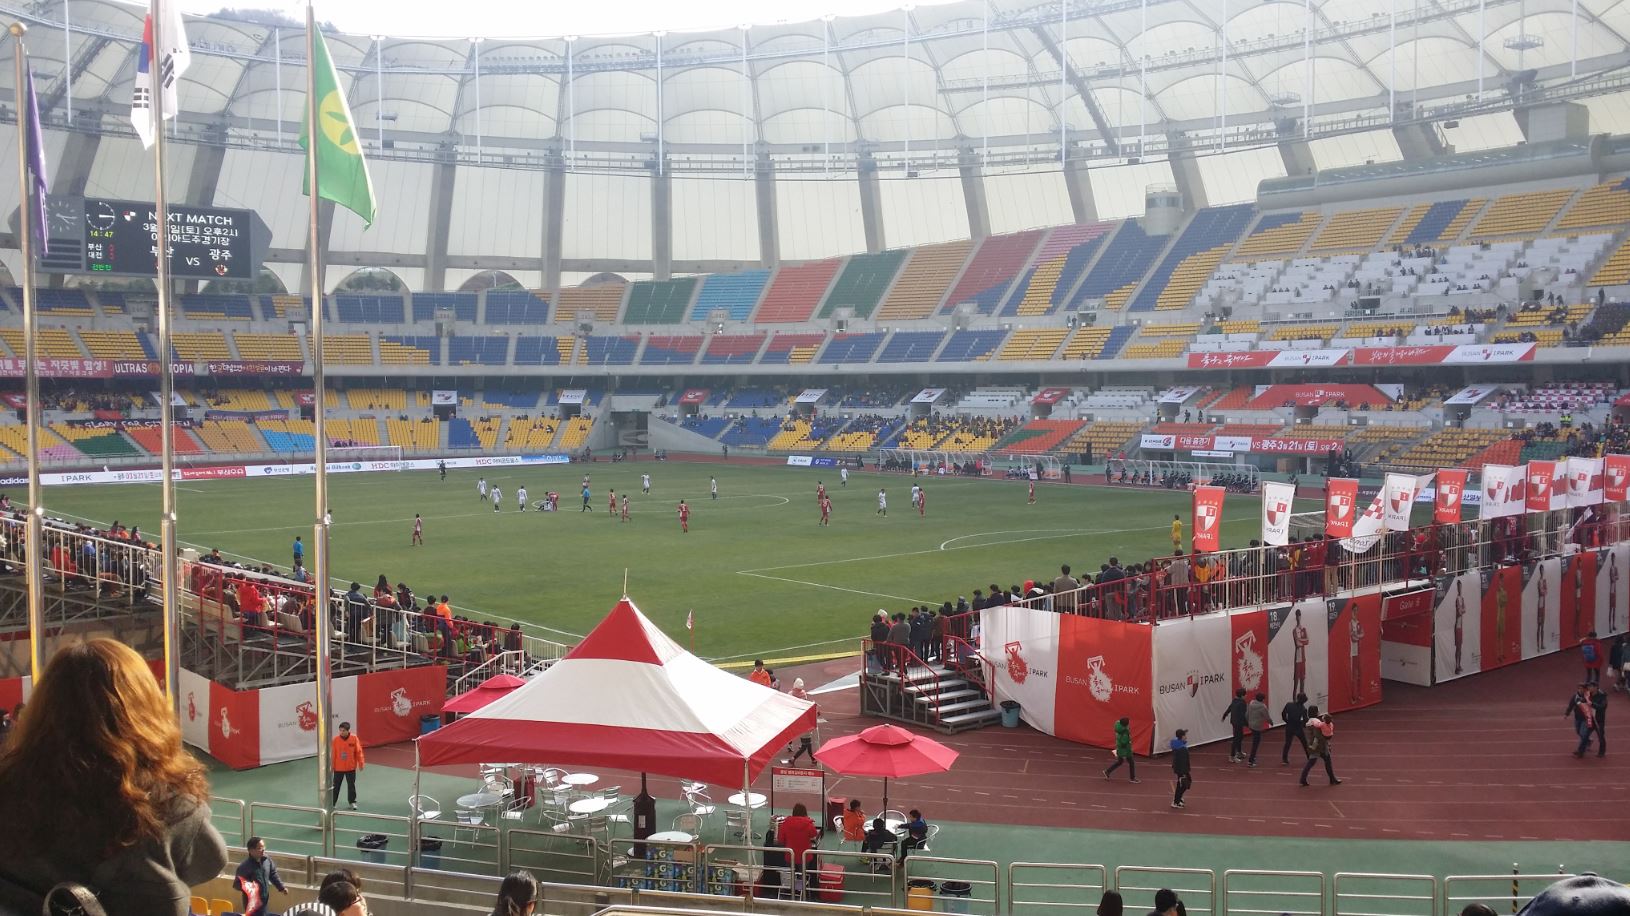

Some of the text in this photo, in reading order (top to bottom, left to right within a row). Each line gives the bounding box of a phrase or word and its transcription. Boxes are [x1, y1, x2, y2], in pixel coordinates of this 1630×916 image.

[148, 211, 233, 225] NXT MATCH
[203, 227, 238, 237] 오후2시
[88, 243, 102, 251] 부산
[209, 248, 233, 261] 광주
[185, 257, 200, 266] VS
[114, 362, 148, 374] ULTRAS
[1251, 441, 1261, 449] VS
[1261, 439, 1277, 450] 광주
[1304, 440, 1318, 451] (토)
[371, 462, 390, 470] HDC
[1328, 601, 1336, 612] 19
[1269, 611, 1278, 622] 18
[1029, 667, 1048, 678] IPARK
[1065, 675, 1087, 686] BUSAN
[1114, 684, 1140, 694] IPARK
[1158, 682, 1186, 695] BUSAN
[1200, 672, 1225, 686] IPARK
[278, 721, 297, 729] BUSAN
